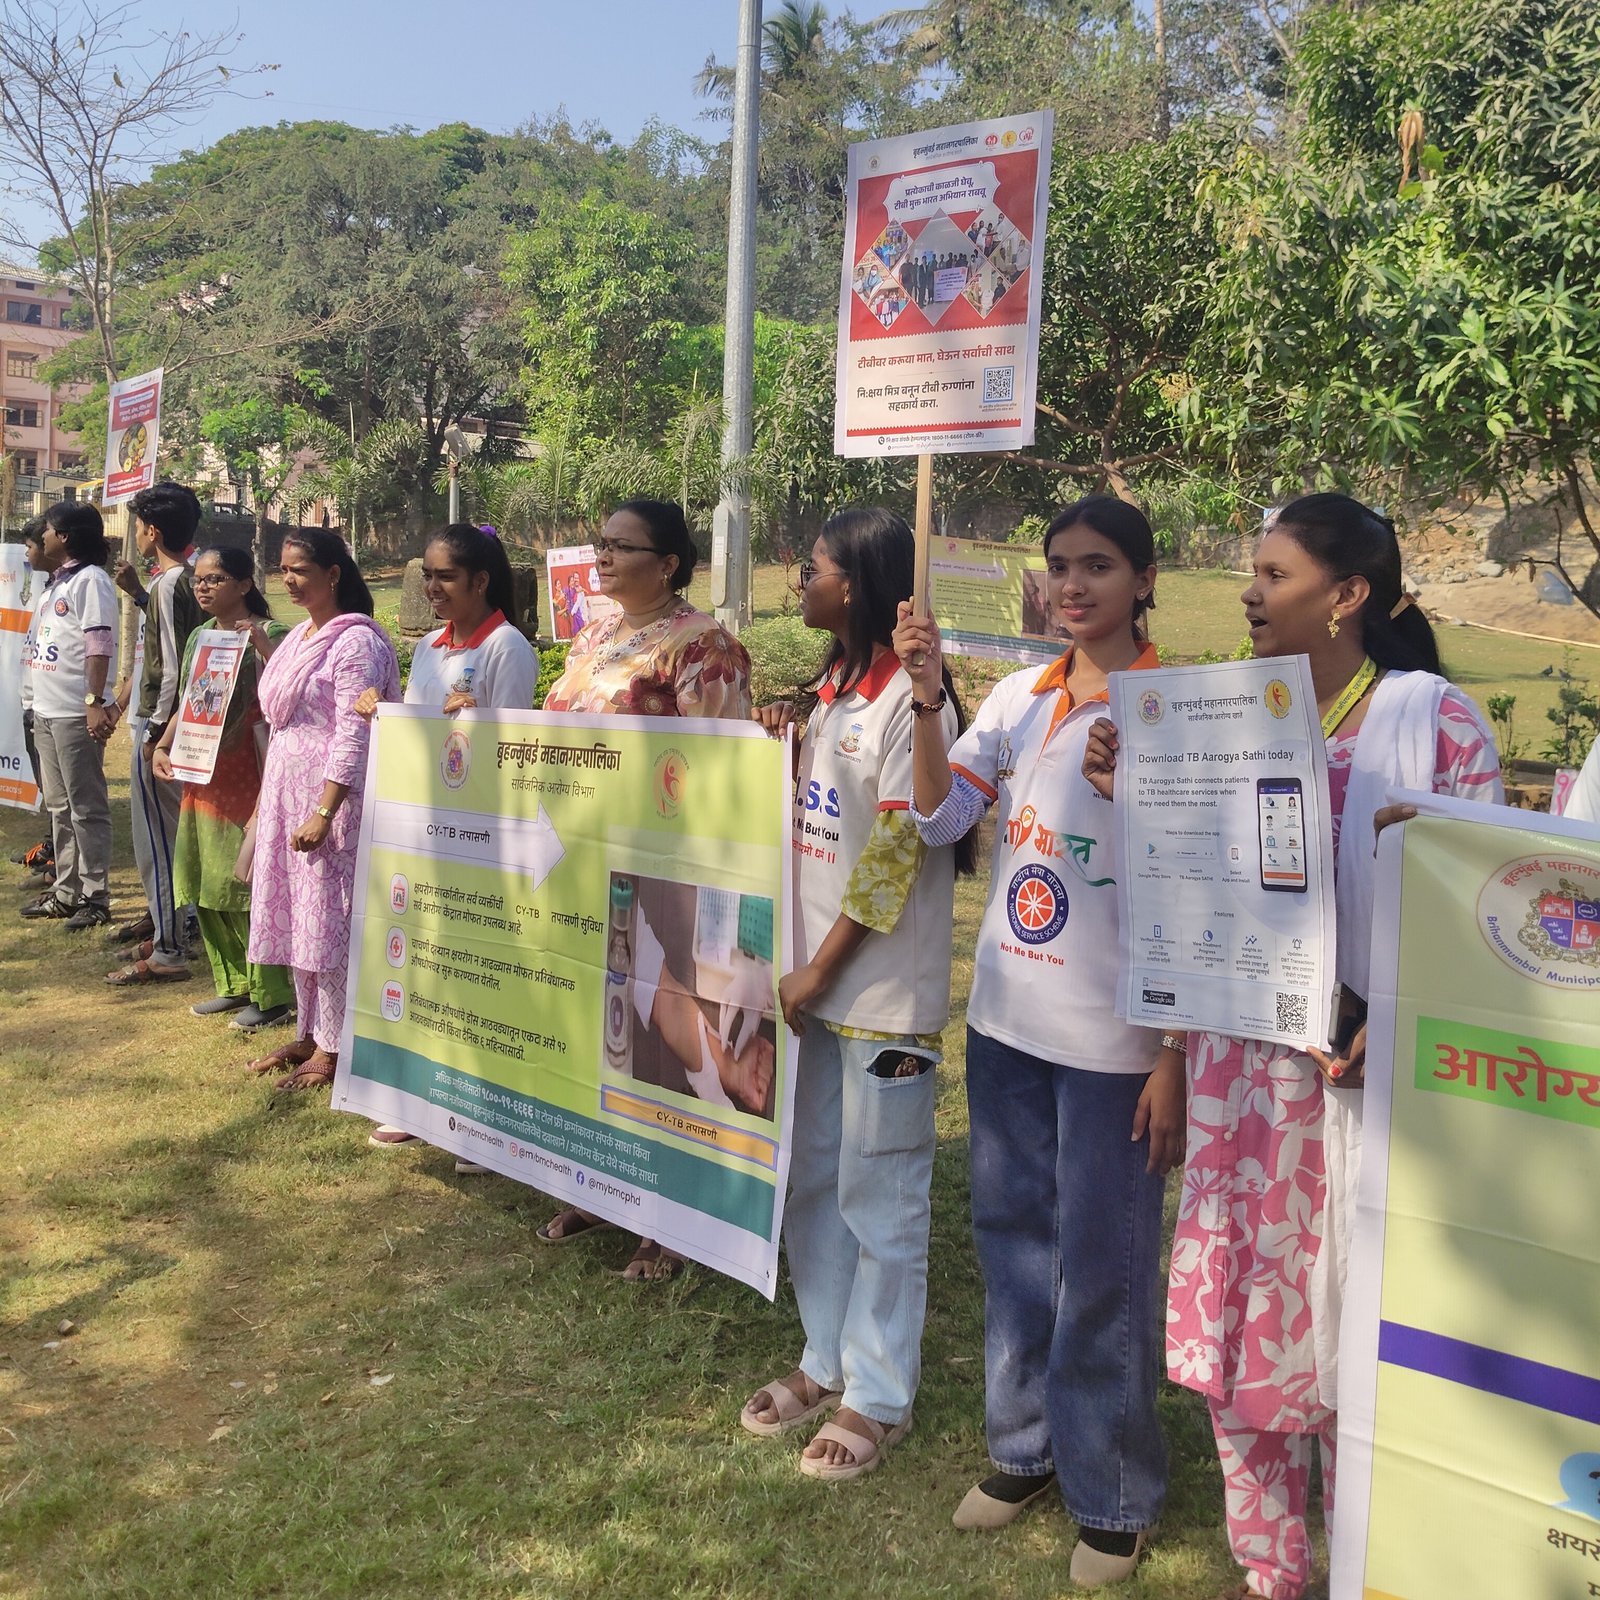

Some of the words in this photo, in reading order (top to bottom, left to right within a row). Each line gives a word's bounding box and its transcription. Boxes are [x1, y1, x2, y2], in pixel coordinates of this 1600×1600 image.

[913, 143, 935, 158] बृहन्मुंबई
[936, 136, 978, 151] महानगरपालिका
[936, 178, 959, 190] काळजी
[894, 198, 909, 210] टीबी
[909, 196, 921, 210] मुक्त
[922, 194, 938, 205] भारत
[940, 190, 966, 202] अभियान
[858, 356, 887, 368] टीबीवर
[916, 351, 935, 364] मात,
[937, 349, 960, 362] घेऊन
[994, 344, 1015, 356] साथ
[884, 384, 900, 396] मित्र
[921, 381, 940, 394] टीबी
[888, 398, 918, 412] सहकार्य
[920, 399, 938, 408] करा.
[42, 664, 57, 672] YOU
[1172, 697, 1204, 713] बृहन्मुंबई
[1204, 694, 1258, 709] महानगरपालिका
[1188, 712, 1214, 722] सार्वजनिक
[497, 738, 539, 769] बृहन्मुंबई
[540, 742, 622, 771] महानगरपालिका
[1138, 752, 1184, 764] Download
[1187, 752, 1200, 762] TB
[1201, 751, 1240, 764] Aarogya
[1242, 750, 1266, 761] Sathi
[1268, 750, 1294, 762] today
[511, 777, 544, 794] सार्वजनिक
[546, 781, 570, 796] आरोग्य
[572, 780, 595, 799] विभाग
[1146, 788, 1156, 796] TB
[1156, 788, 1190, 796] healthcare
[1219, 788, 1237, 796] when
[1149, 777, 1176, 786] Aarogya
[1176, 776, 1193, 784] Sathi
[1194, 776, 1223, 784] connects
[1224, 776, 1250, 785] patients
[1138, 800, 1152, 808] they
[1154, 800, 1170, 808] need
[1170, 800, 1187, 808] them
[1188, 800, 1198, 808] the
[1199, 800, 1218, 808] most.
[426, 824, 456, 840] CY-TB
[458, 830, 490, 844] तपासणी
[805, 822, 820, 836] But
[1500, 861, 1542, 888] बृहन्मुंबई
[413, 898, 422, 910] सर्व
[462, 908, 482, 925] मोफत
[483, 916, 507, 930] उपलब्ध
[414, 882, 434, 896] क्षयरोग
[466, 891, 478, 905] सर्व
[516, 905, 540, 918] CY-TB
[551, 912, 579, 928] तपासणी
[580, 915, 604, 935] सुविधा
[1010, 902, 1023, 934] NATIONAL
[1021, 930, 1045, 940] SERVICE
[1044, 915, 1064, 938] SCHEME
[1000, 942, 1012, 954] Not
[1014, 946, 1026, 958] Me
[1028, 950, 1044, 962] But
[1046, 954, 1064, 966] You
[1487, 916, 1542, 975] Brihanmumbai
[451, 949, 473, 964] क्षयरोग
[474, 955, 480, 966] न
[514, 962, 534, 980] मोफत
[535, 968, 576, 992] प्रतिबंधात्मक
[454, 967, 480, 985] करण्यात
[462, 1026, 480, 1044] दैनिक
[466, 1010, 480, 1026] डोस
[542, 1034, 556, 1050] असे
[557, 1040, 566, 1054] १२
[541, 1109, 554, 1125] टोल
[564, 1121, 594, 1142] क्रमांकावर
[595, 1130, 614, 1148] संपर्क
[615, 1138, 632, 1156] साधा
[656, 1111, 684, 1129] CY-TB
[686, 1122, 718, 1140] तपासणी
[570, 1142, 592, 1160] आरोग्य
[606, 1154, 618, 1170] येथे
[618, 1160, 638, 1177] संपर्क
[588, 1177, 641, 1207] @mybmcphd
